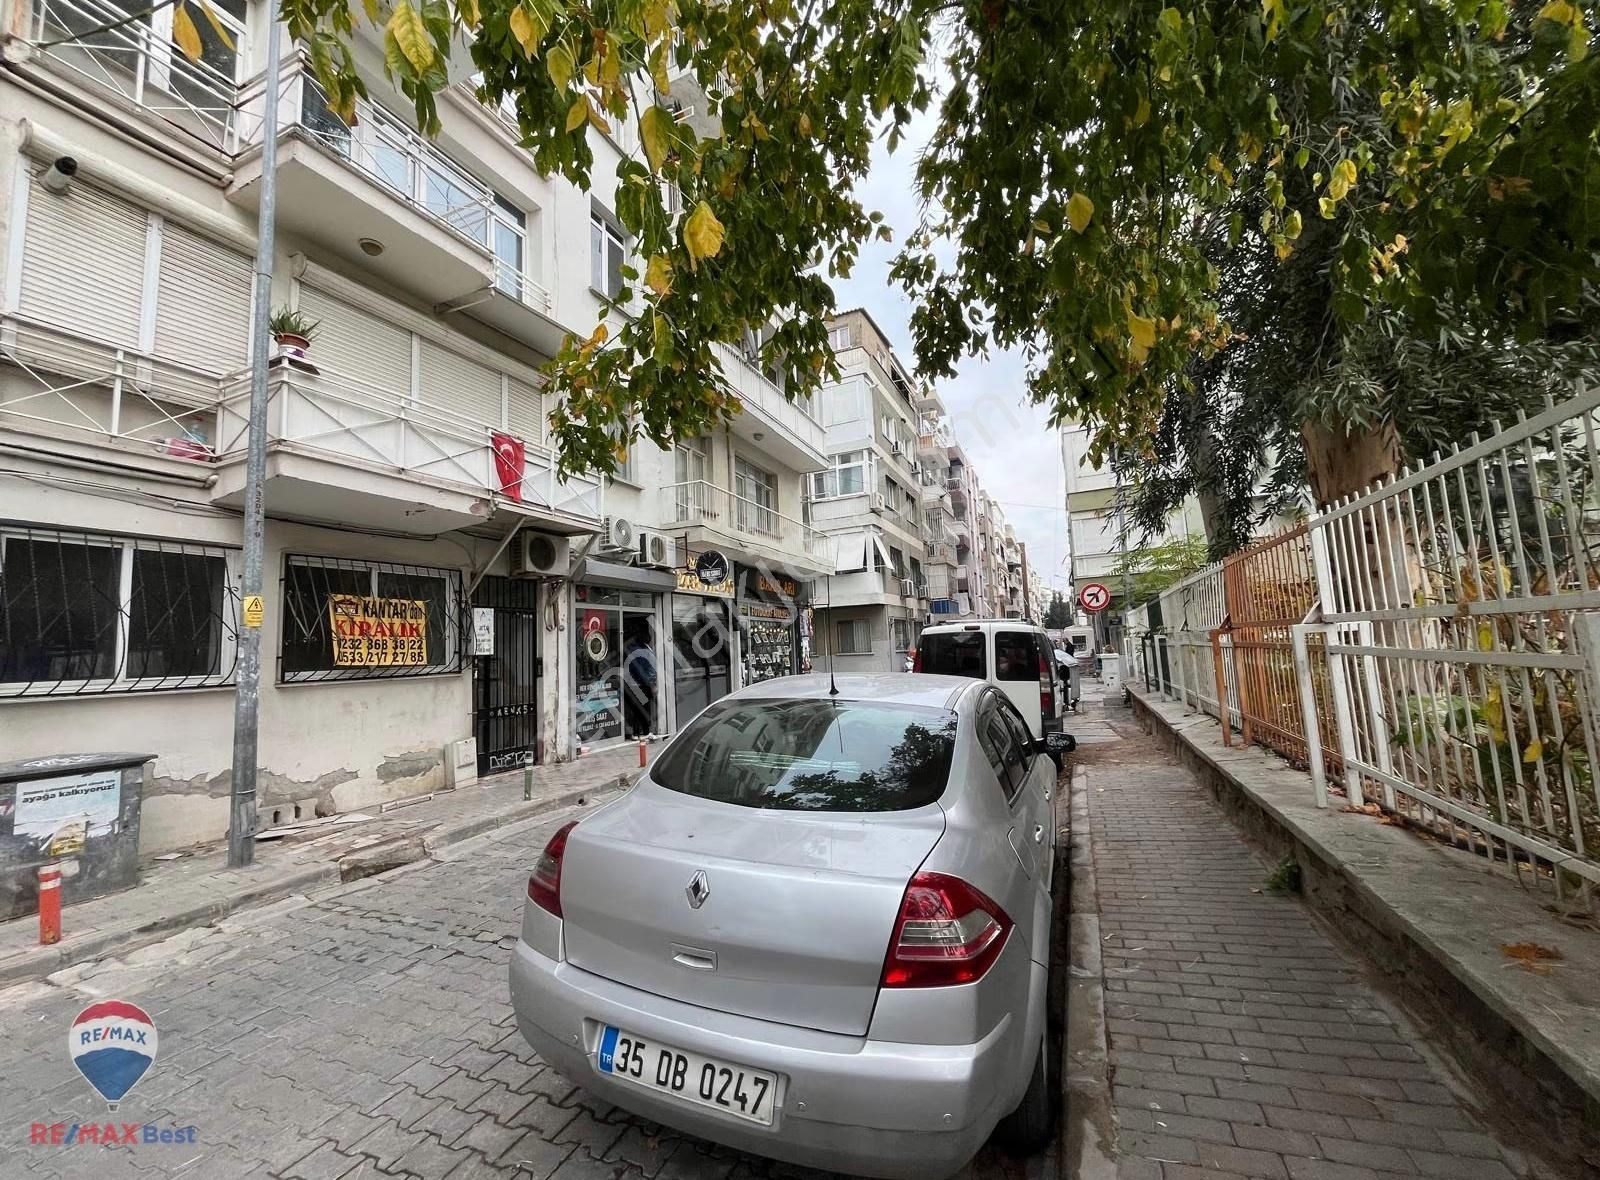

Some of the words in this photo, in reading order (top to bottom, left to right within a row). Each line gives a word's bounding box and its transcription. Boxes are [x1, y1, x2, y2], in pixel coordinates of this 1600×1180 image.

[336, 620, 422, 637] KIRALIK
[392, 640, 405, 650] 38
[409, 640, 423, 650] 22
[367, 652, 388, 663] 217
[392, 652, 406, 663] 27
[410, 652, 424, 663] 85
[602, 1052, 613, 1064] TR
[616, 1038, 646, 1078] 35
[656, 1049, 689, 1092] DB
[699, 1062, 770, 1115] 0247
